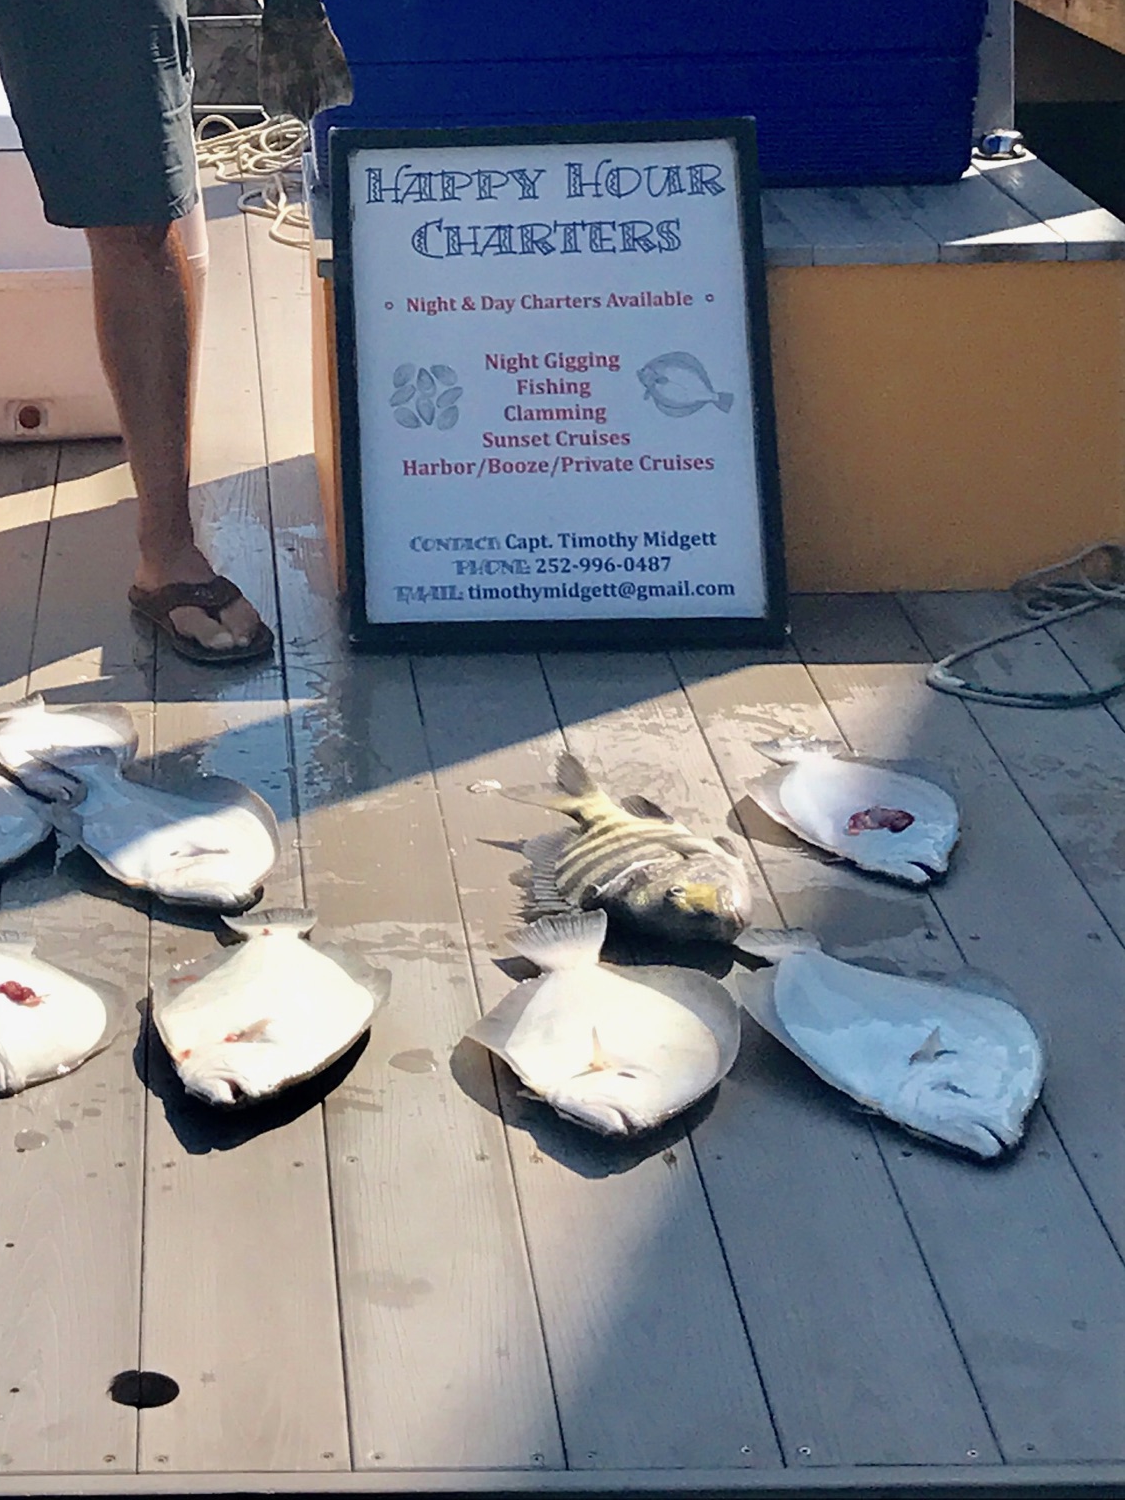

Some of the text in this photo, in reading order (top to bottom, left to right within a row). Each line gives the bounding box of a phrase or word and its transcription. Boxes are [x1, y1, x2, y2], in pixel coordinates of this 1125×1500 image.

[365, 159, 726, 203] HAPPY HOUR
[411, 217, 682, 258] CHARTERS
[406, 291, 693, 315] Night & Day Charters Available
[485, 352, 621, 372] Night Gigging
[516, 379, 592, 398] Fishing
[503, 405, 607, 424] Clamming
[482, 430, 631, 449] Sunset Cruises
[402, 455, 715, 479] Harbor/Booze/Private Cruises
[505, 534, 554, 553] Capt.
[558, 532, 637, 551] Timothy
[643, 531, 718, 547] Midgett
[536, 556, 672, 574] 252-996-0487
[468, 581, 736, 602] timothymidgett@gmail.com
